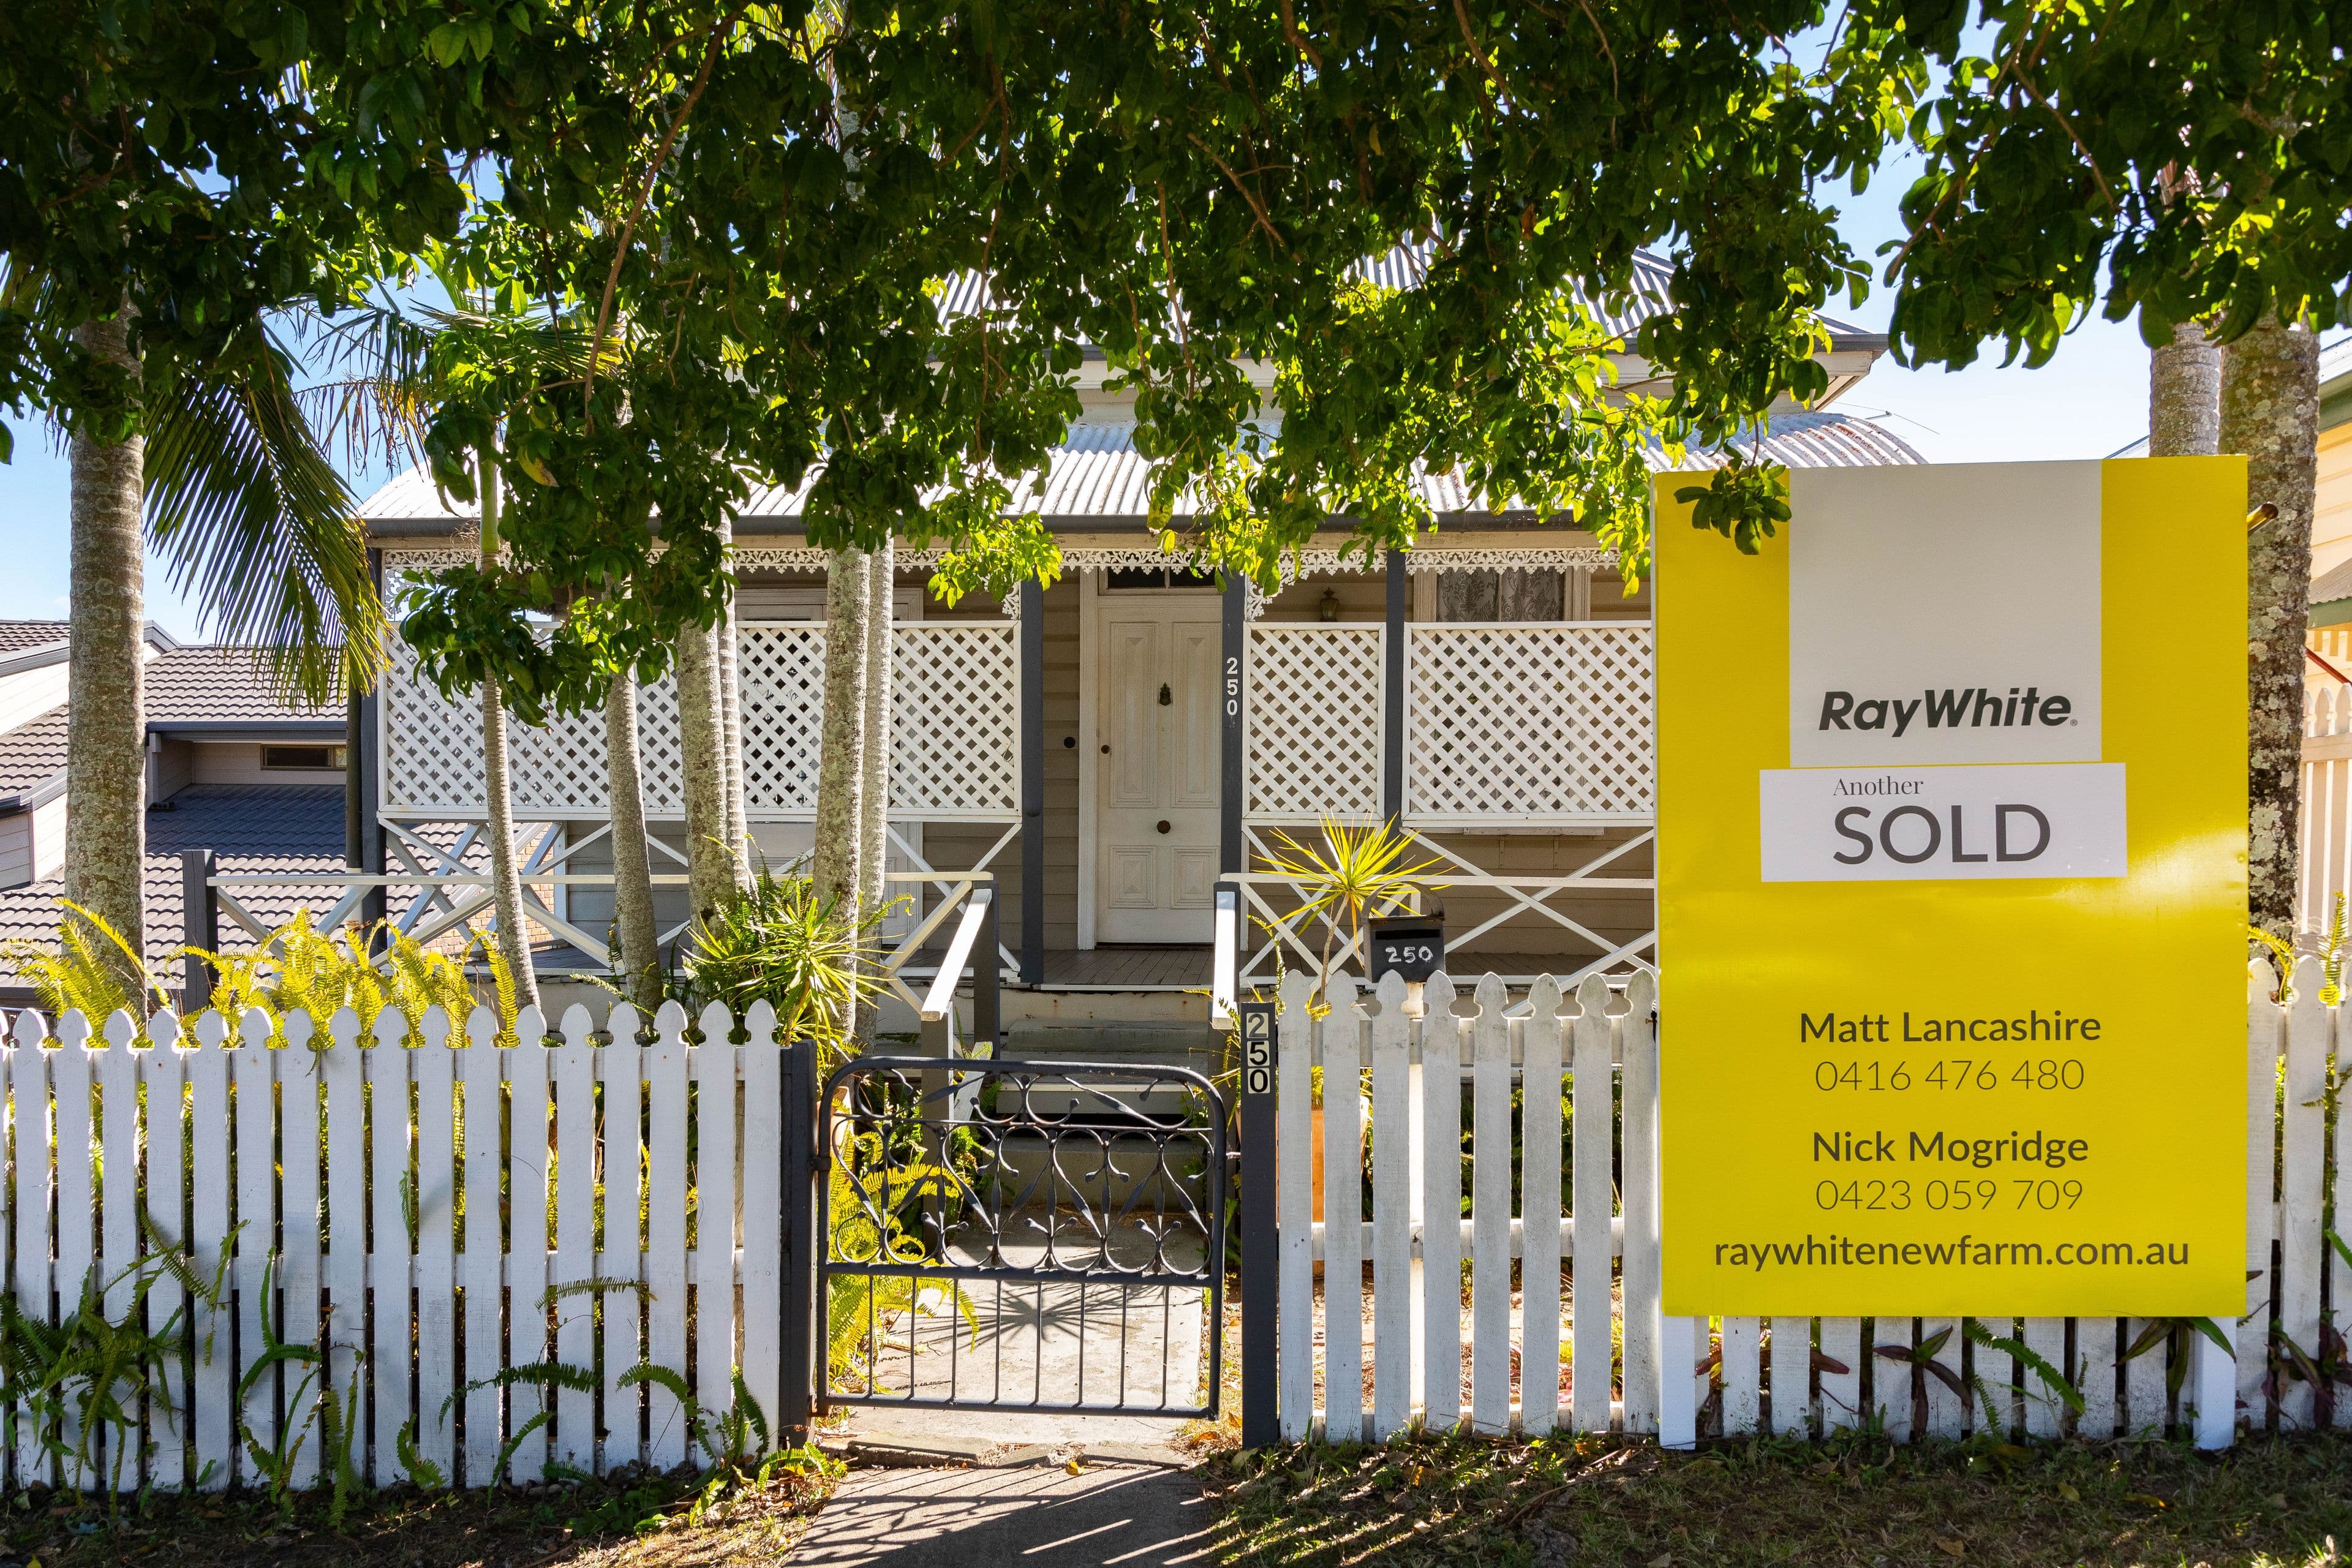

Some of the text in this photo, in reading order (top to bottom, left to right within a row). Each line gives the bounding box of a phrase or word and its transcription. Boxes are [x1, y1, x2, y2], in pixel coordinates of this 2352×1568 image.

[1226, 657, 1238, 716] 250
[1833, 776, 1923, 796] Another
[1833, 804, 2050, 865] SOLD
[1385, 946, 1433, 963] 250
[1801, 1010, 2101, 1043] Matt Lancashire
[1248, 1013, 1268, 1093] 250
[1815, 1059, 2084, 1091] 0416 476 480
[1814, 1130, 2089, 1168] Nick Mogridge
[1816, 1180, 2082, 1210] 0423 059 709
[1716, 1234, 2188, 1272] raywhitenewfarm.com.au
